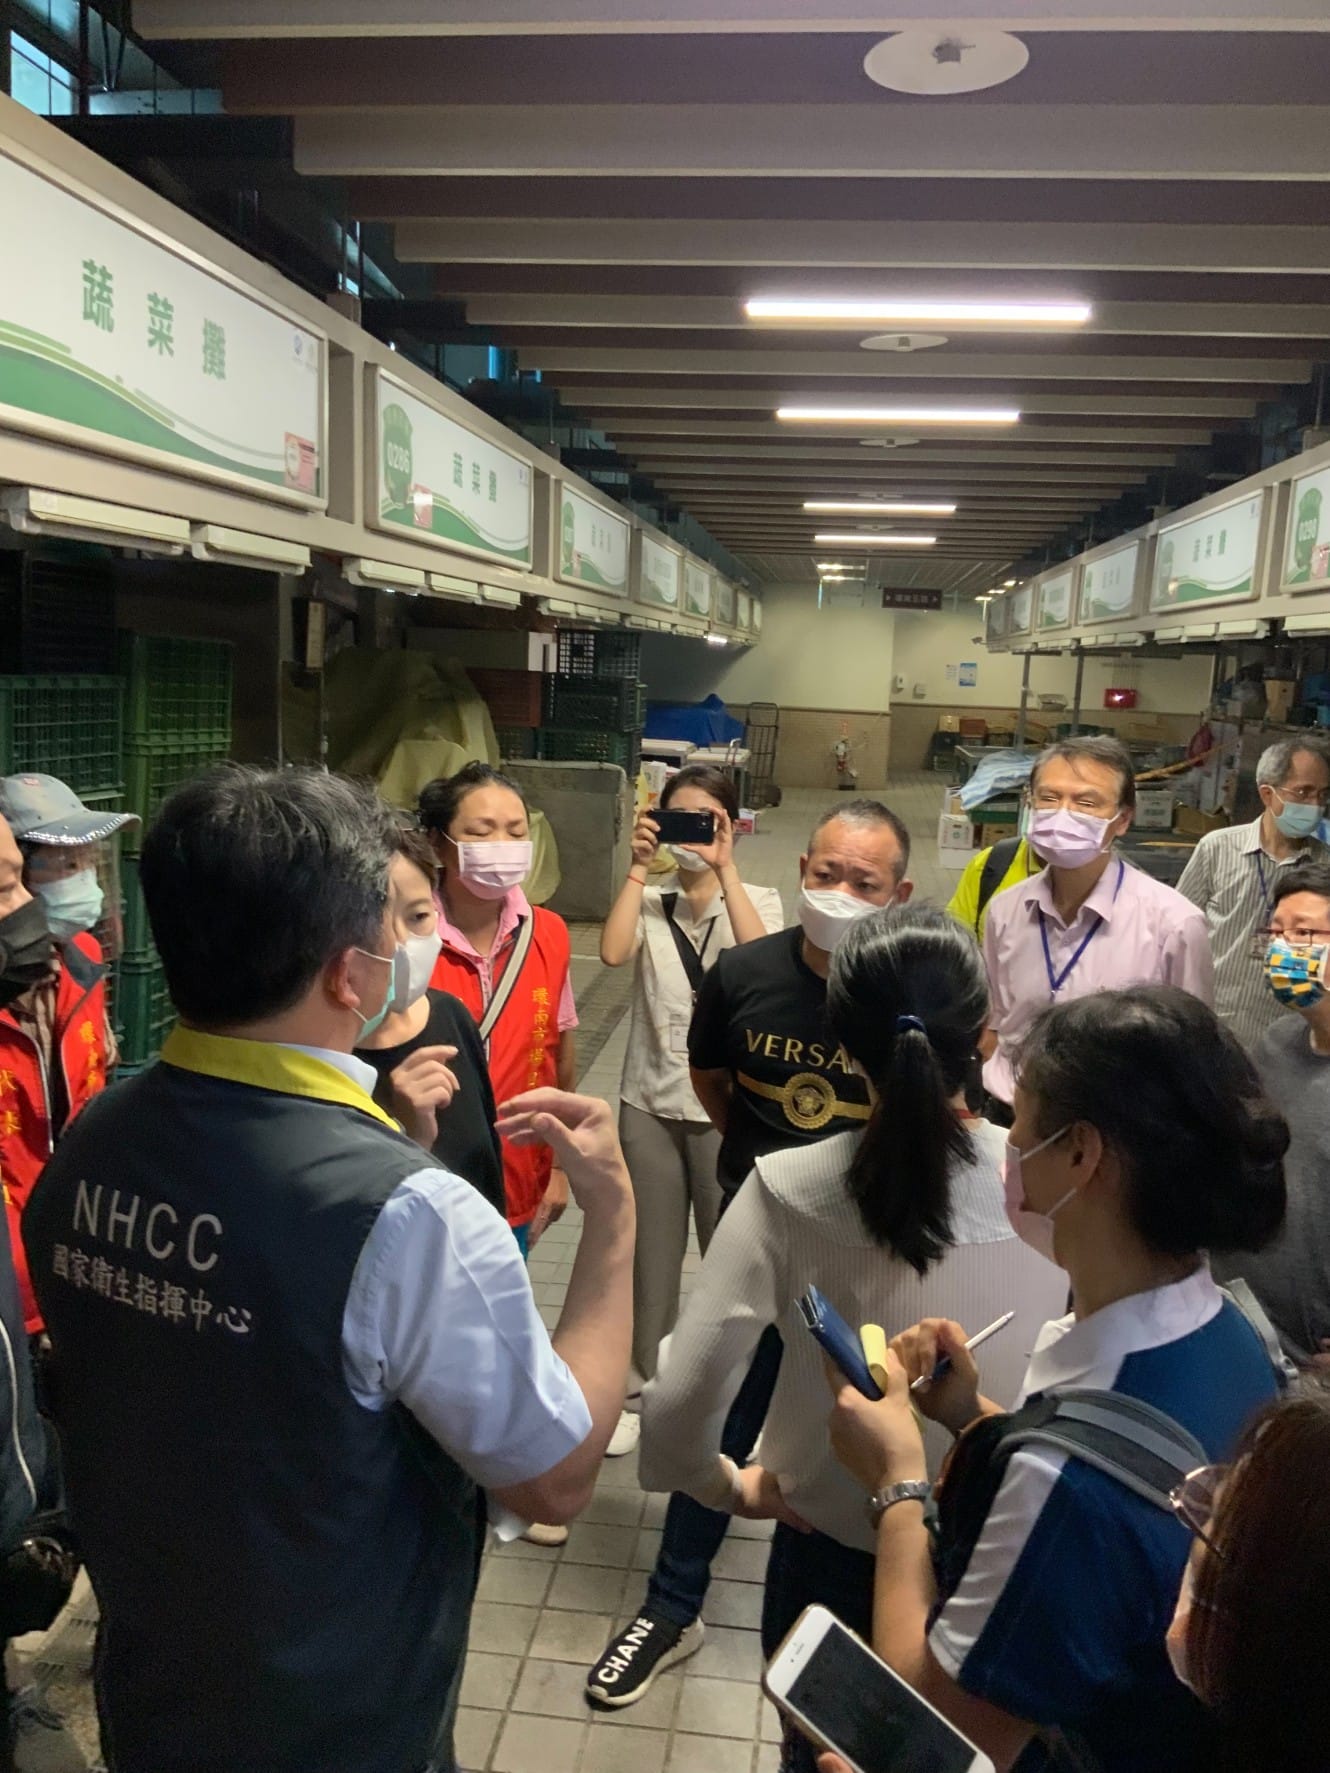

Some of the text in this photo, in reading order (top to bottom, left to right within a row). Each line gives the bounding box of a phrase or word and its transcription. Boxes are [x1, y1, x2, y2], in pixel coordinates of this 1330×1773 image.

[73, 1180, 222, 1271] NHCC
[53, 1244, 251, 1333] 國家衛生指揮中心
[598, 1618, 655, 1683] CHANE
